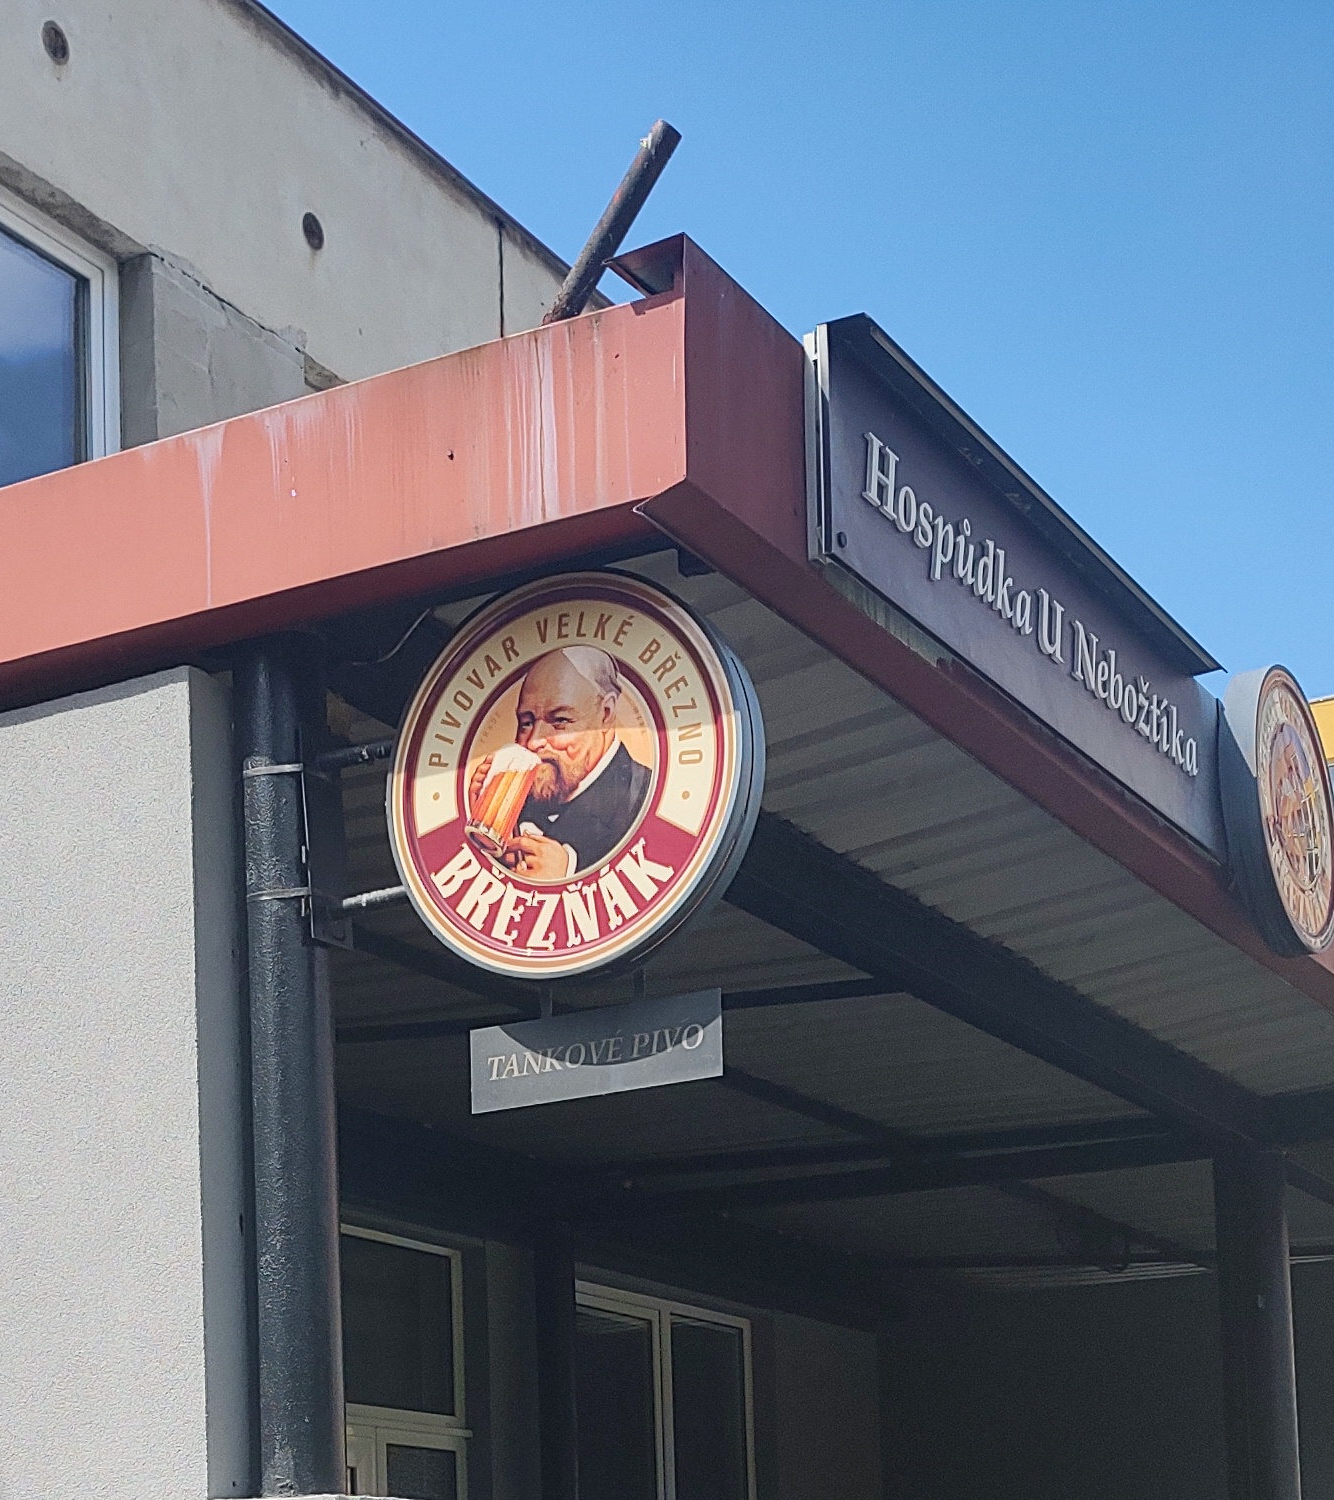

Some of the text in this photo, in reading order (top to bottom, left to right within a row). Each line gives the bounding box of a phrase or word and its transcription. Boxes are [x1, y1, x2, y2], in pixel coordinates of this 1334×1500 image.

[862, 432, 1033, 635] Hospůdka
[1036, 588, 1065, 664] U
[1071, 619, 1199, 777] Nebožtíka
[428, 611, 704, 768] PIVOVAR VELKÉ BŘEZNO
[430, 837, 676, 952] BŘEZŇÁK
[487, 1023, 705, 1081] TANKOVÉ PIVO
